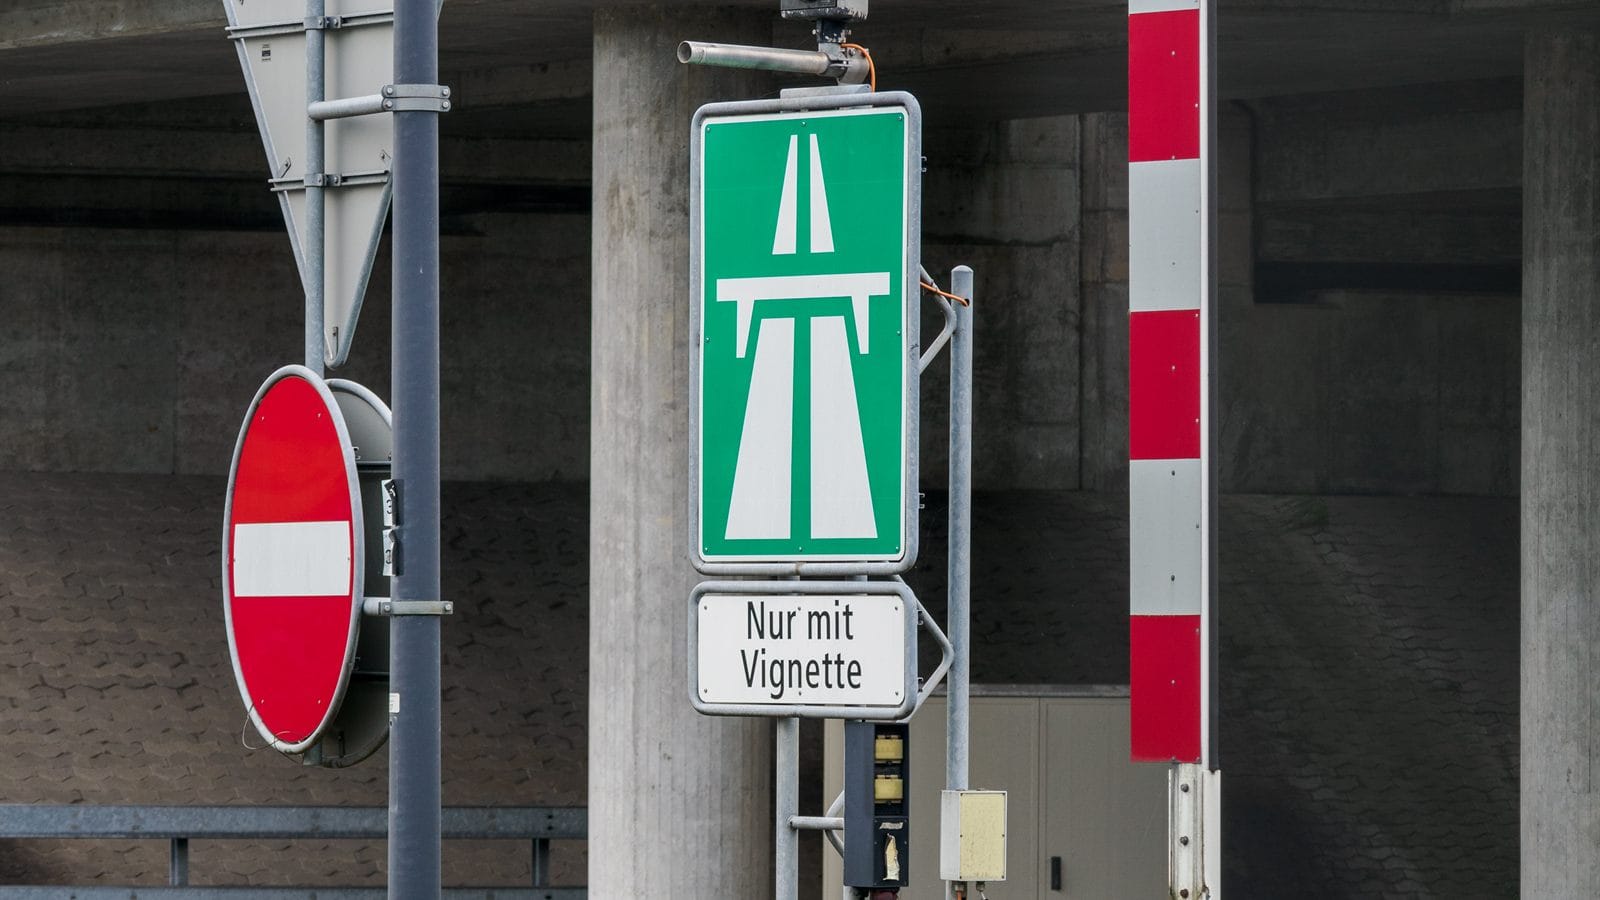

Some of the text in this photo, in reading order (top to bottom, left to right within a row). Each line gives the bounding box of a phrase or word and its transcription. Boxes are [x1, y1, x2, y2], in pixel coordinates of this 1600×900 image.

[747, 599, 854, 640] Nur mit
[740, 647, 862, 700] Vignette
